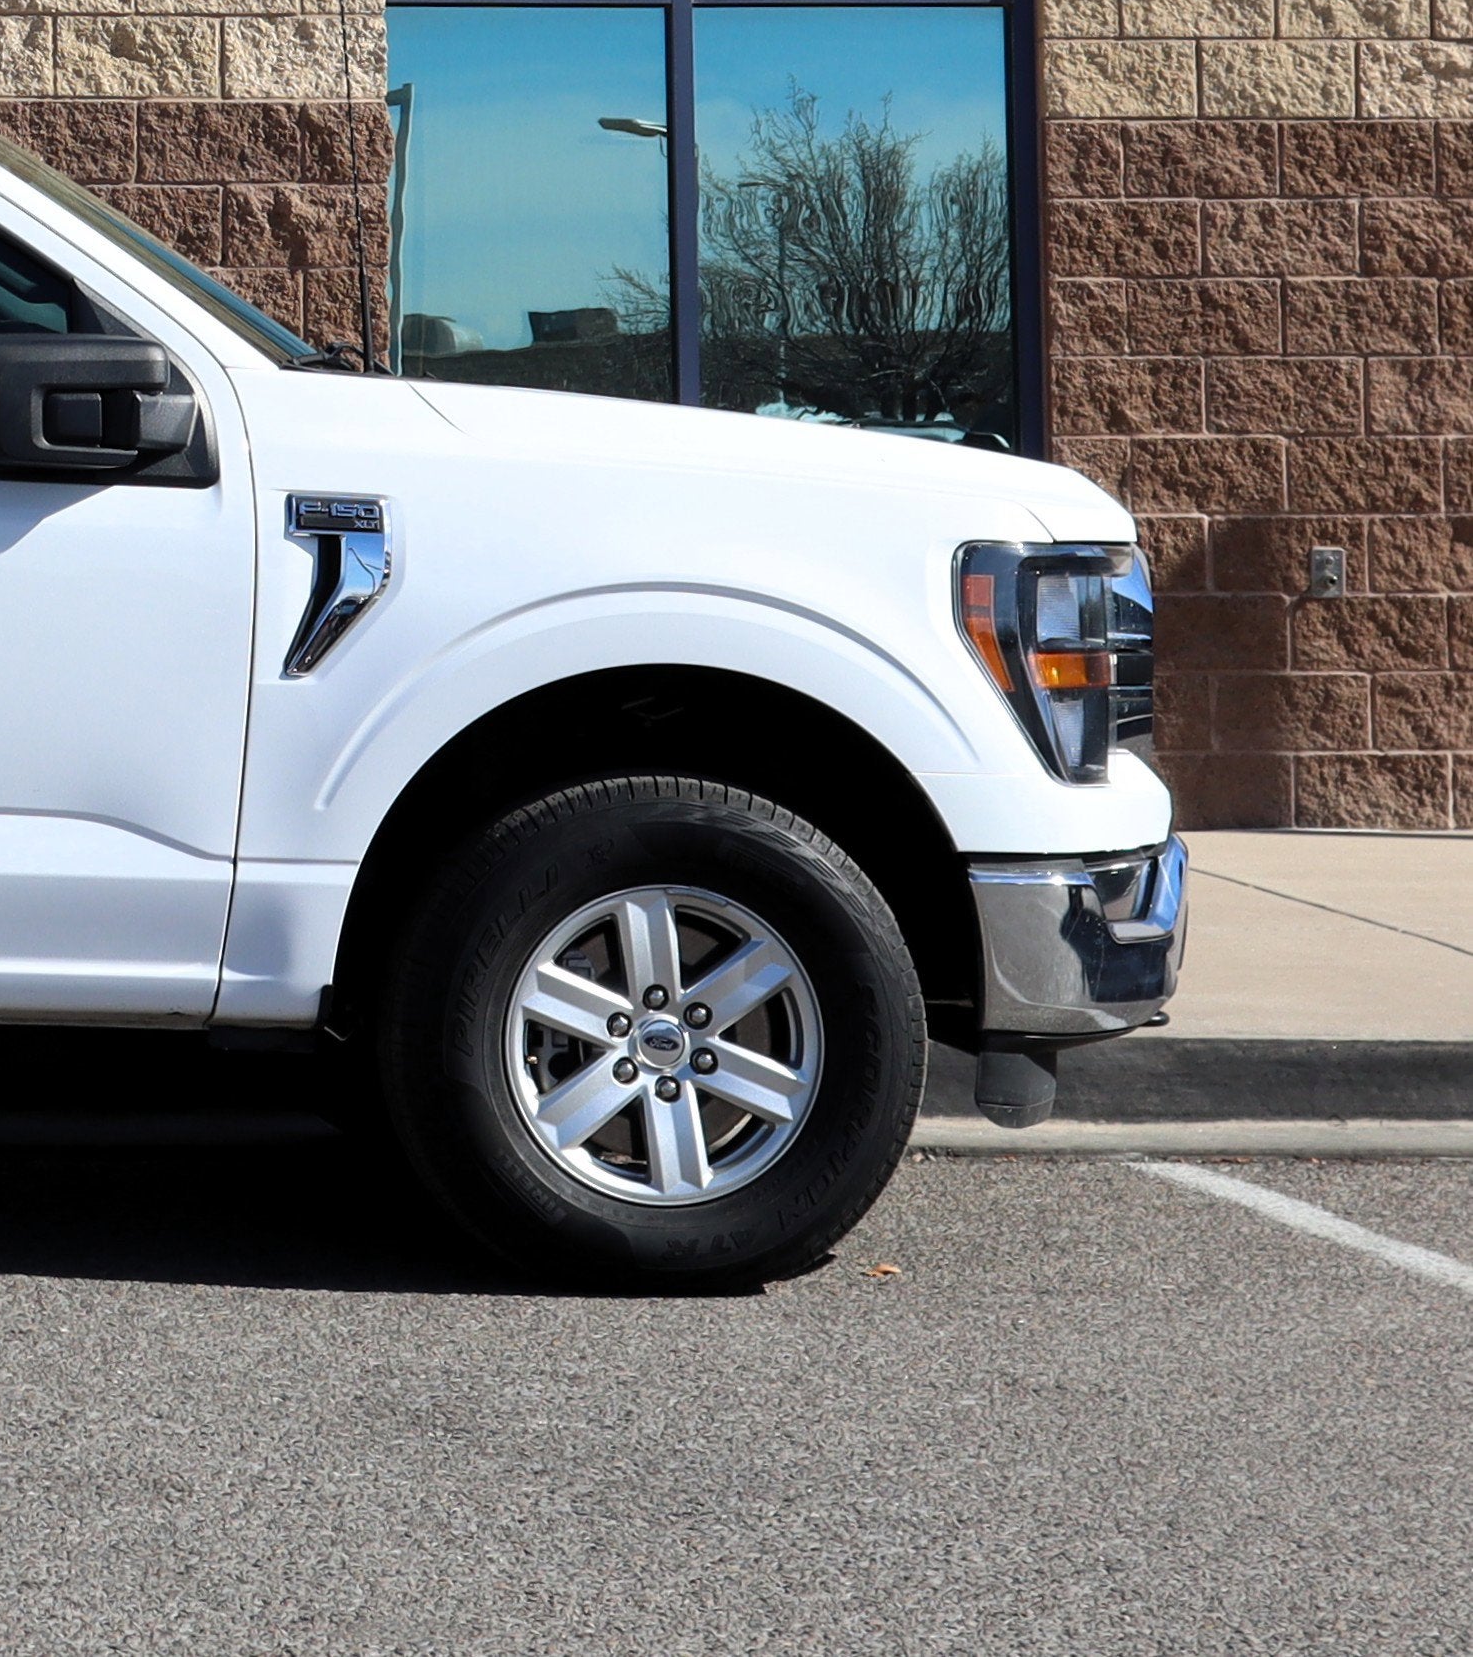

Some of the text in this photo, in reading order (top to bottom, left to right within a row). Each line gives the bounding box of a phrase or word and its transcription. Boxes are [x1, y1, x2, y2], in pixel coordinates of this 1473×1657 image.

[299, 501, 380, 519] F-150
[454, 862, 559, 1057] PIRELLI
[778, 980, 882, 1231] SCORPION
